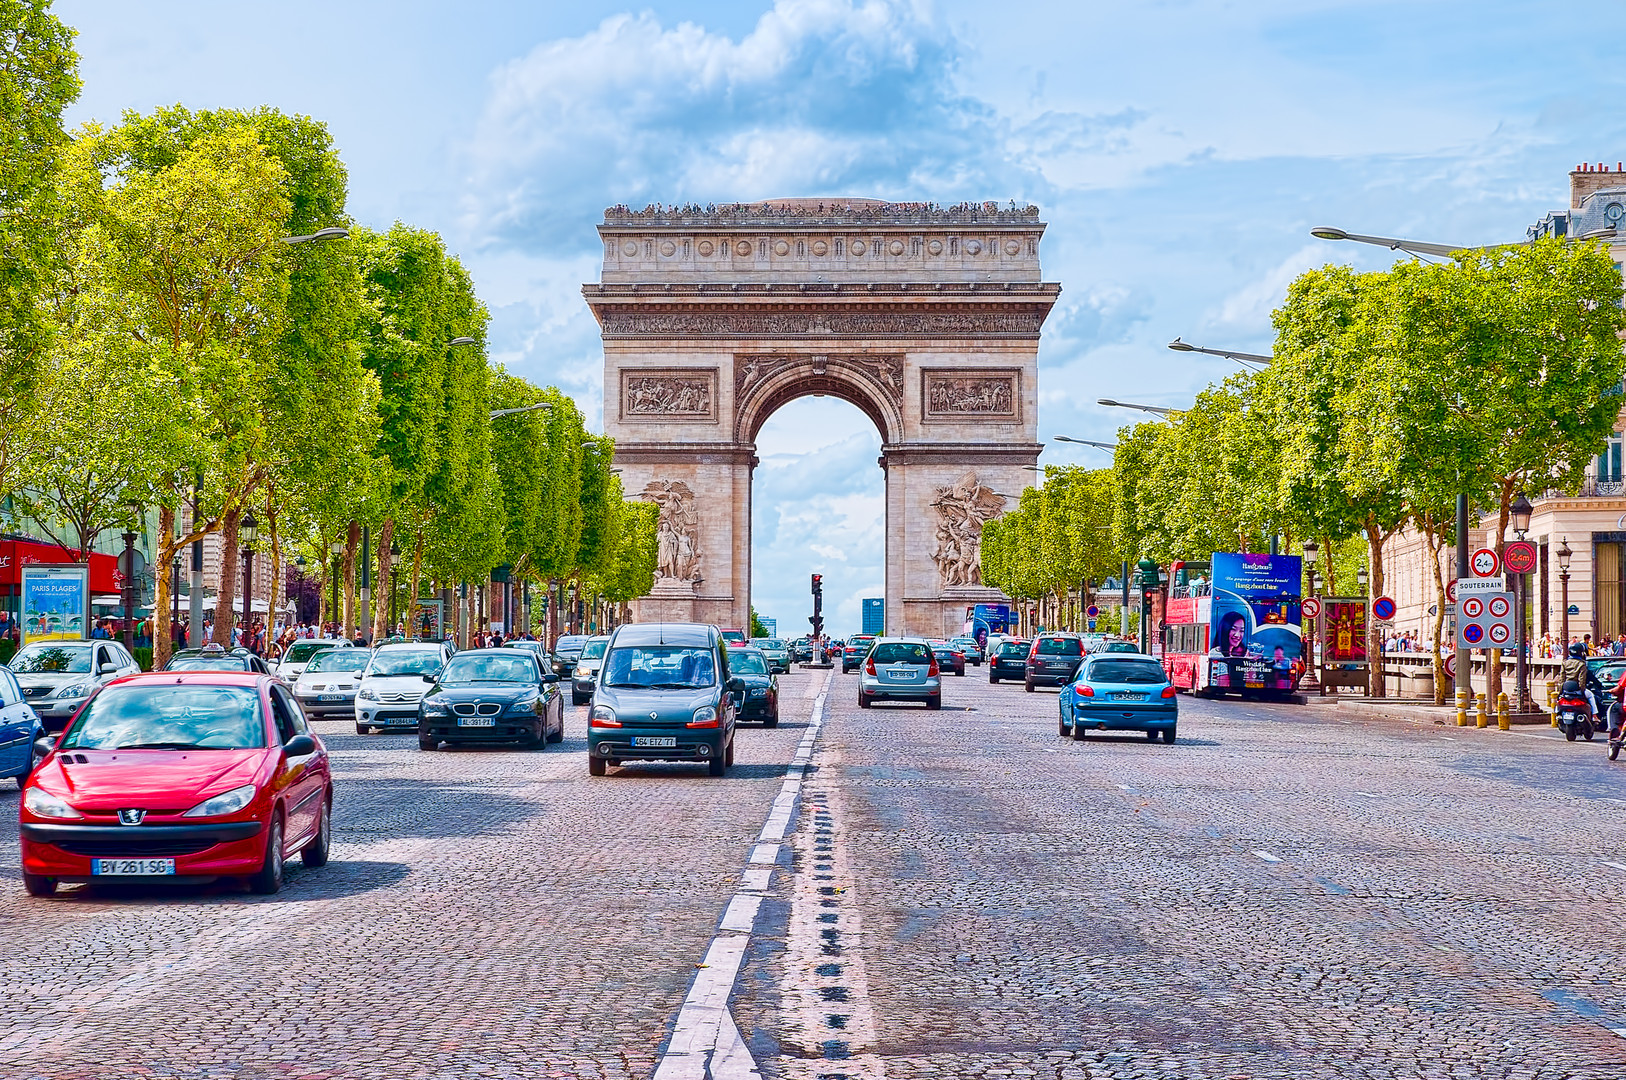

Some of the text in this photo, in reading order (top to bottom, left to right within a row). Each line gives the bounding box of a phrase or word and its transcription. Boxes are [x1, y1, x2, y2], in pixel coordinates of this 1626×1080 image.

[635, 738, 674, 746] 464 ETZ 77
[101, 860, 166, 873] BV-261-SG
